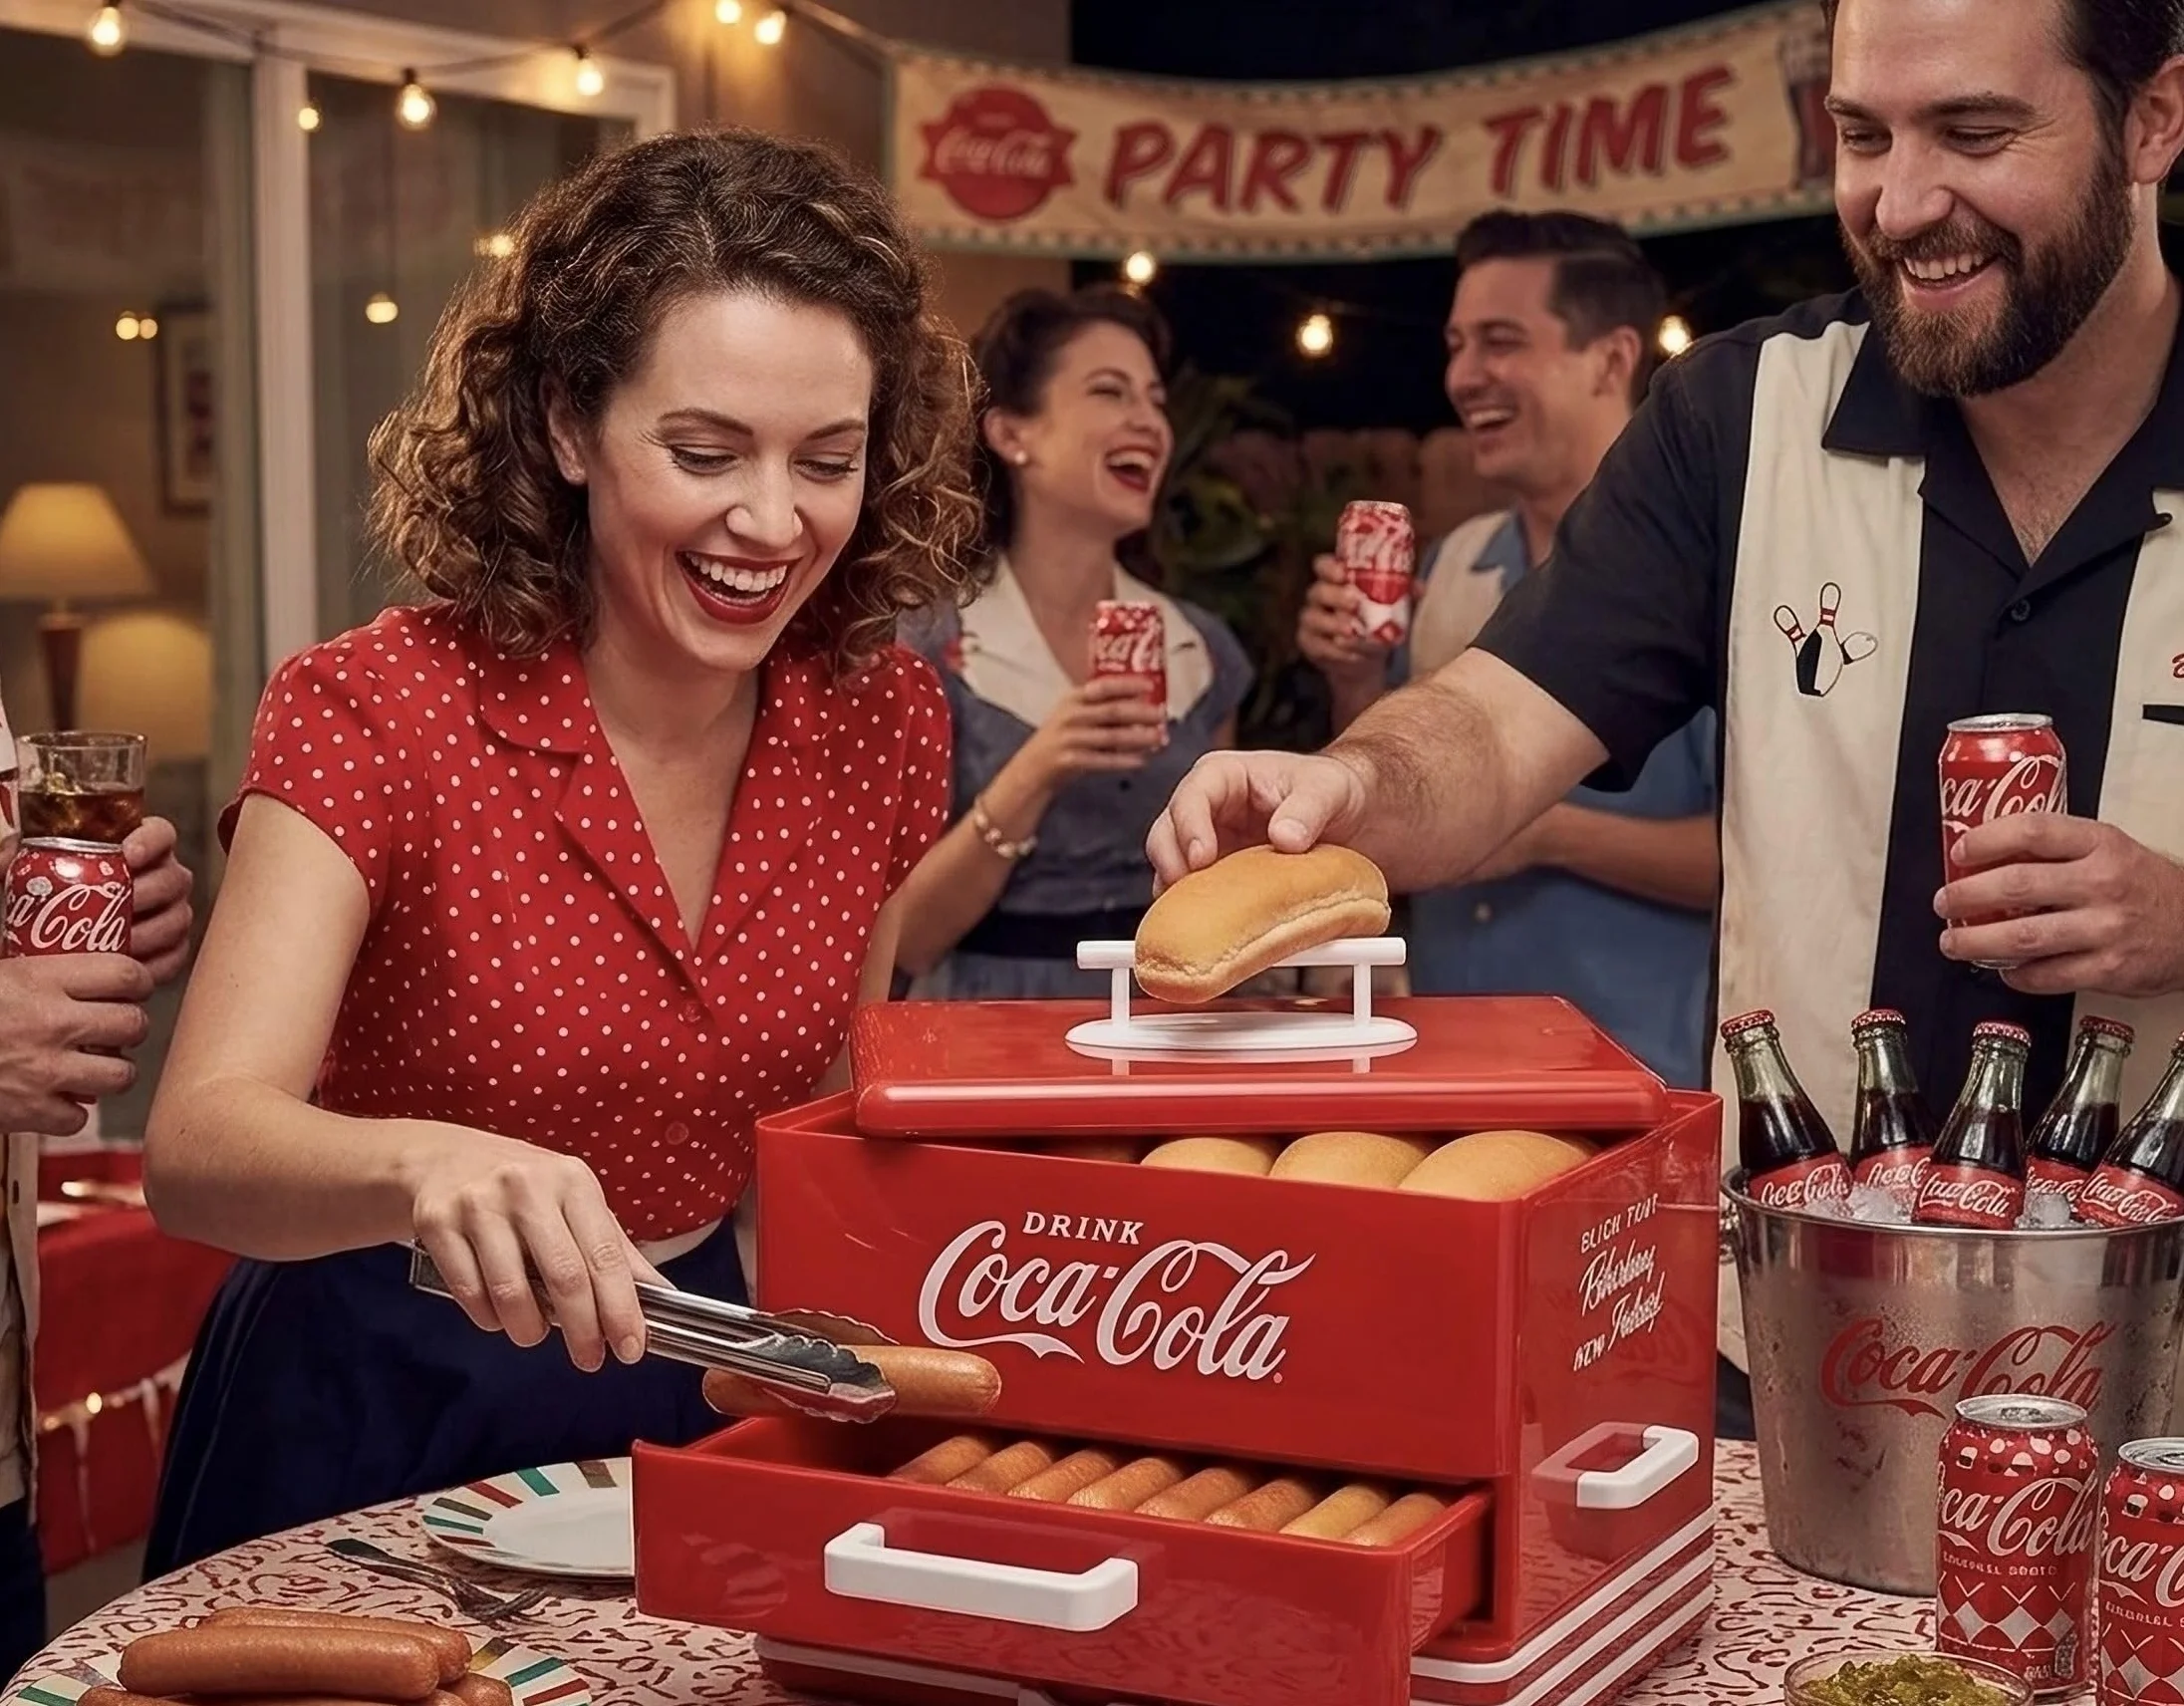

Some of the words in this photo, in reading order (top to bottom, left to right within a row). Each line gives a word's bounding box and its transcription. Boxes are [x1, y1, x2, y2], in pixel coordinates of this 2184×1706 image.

[1103, 121, 1443, 214] PARTY
[1482, 65, 1737, 198] TIME
[918, 1219, 1317, 1382] Coca-Cola
[1021, 1211, 1145, 1247] DRINK
